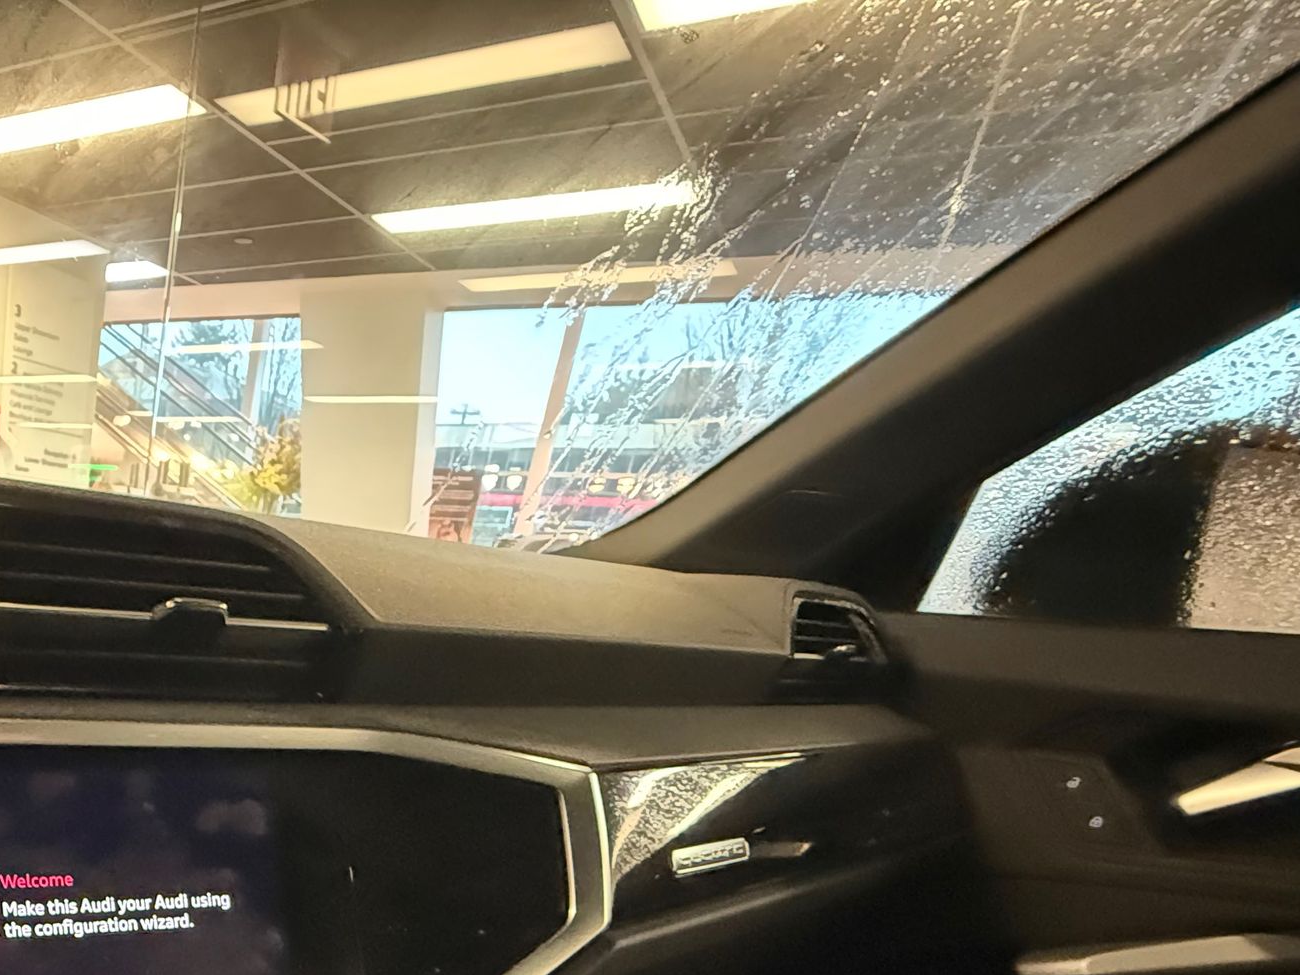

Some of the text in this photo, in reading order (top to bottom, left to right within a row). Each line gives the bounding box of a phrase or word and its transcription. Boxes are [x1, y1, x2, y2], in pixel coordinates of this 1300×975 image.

[0, 874, 75, 890] Welcome
[2, 892, 232, 917] Make this Audi your Audi using
[3, 912, 195, 939] the configuration wizard.
